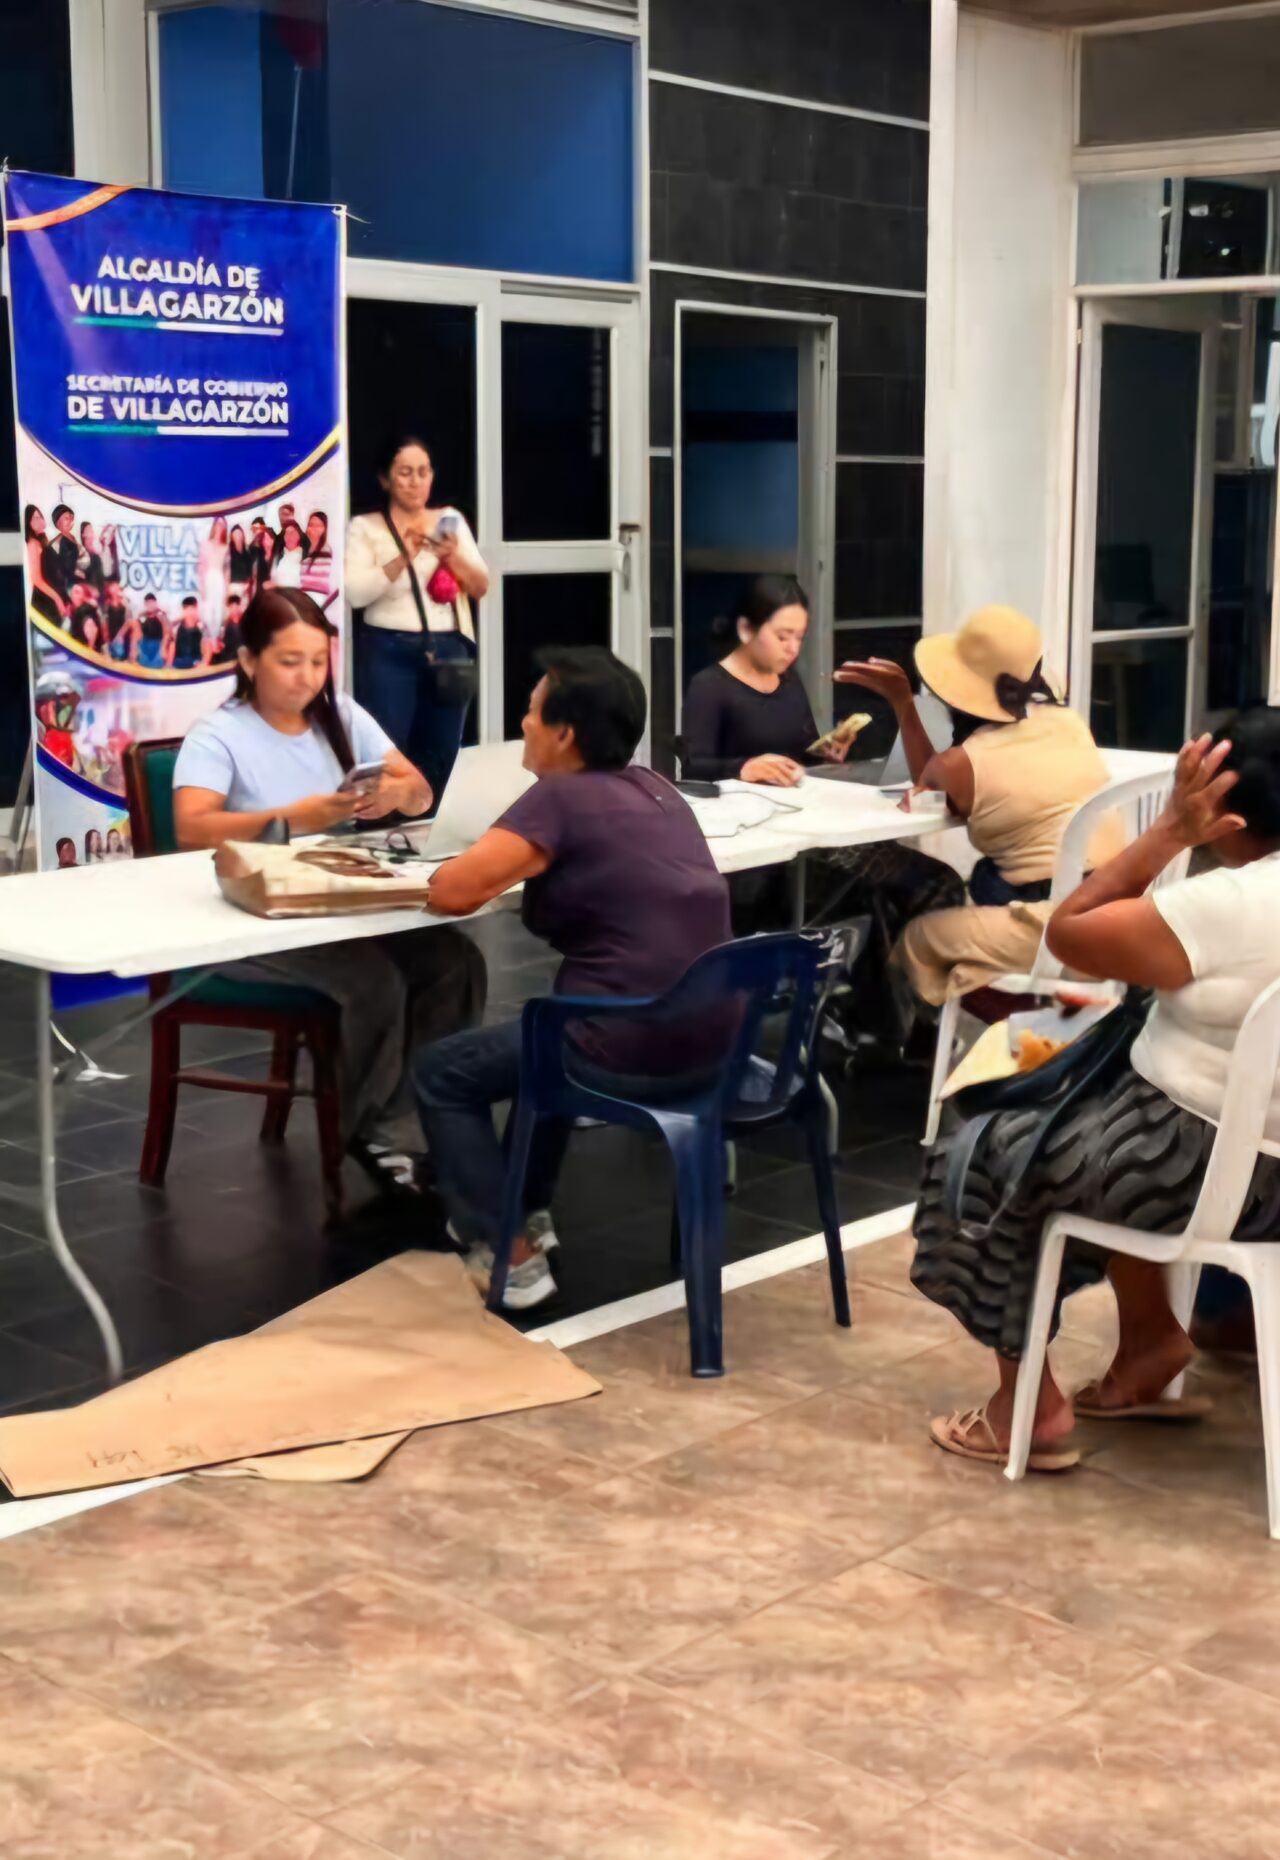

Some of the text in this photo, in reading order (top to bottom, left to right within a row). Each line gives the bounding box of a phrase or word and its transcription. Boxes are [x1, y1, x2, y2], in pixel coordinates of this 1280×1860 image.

[98, 254, 260, 290] ALCALDÍA DE
[70, 284, 285, 324] VILLAGARZÓN
[67, 394, 289, 424] DE VILLAGARZÓN
[116, 523, 200, 558] VILLA
